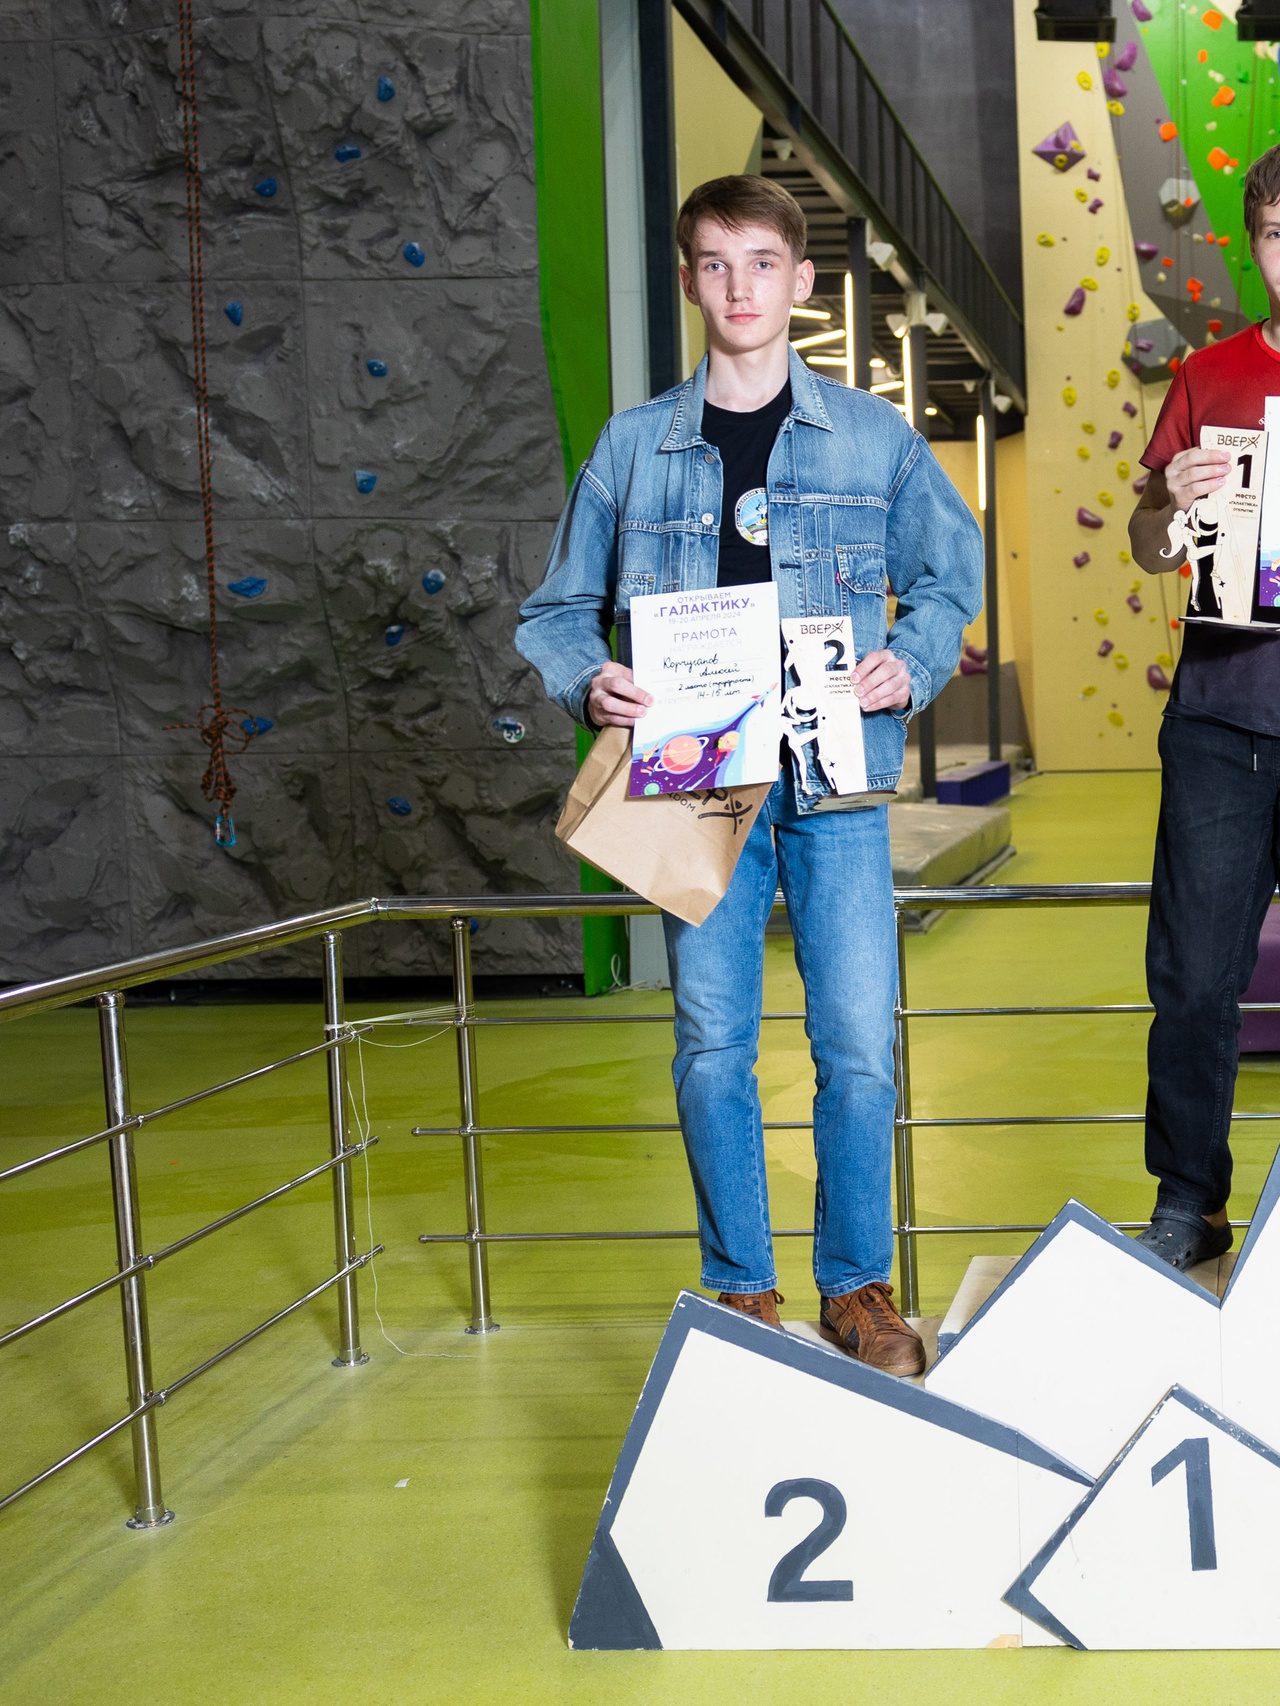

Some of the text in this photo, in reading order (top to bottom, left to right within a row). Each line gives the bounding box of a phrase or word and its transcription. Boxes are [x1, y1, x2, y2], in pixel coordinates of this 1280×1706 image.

[1217, 433, 1261, 452] ВВЕРХ
[1237, 454, 1253, 489] 1
[653, 597, 756, 618] «ГАЛАКТИКУ»
[677, 591, 731, 604] ОТКРЫВАЕМ
[690, 613, 721, 622] АПРЕЛЯ
[723, 611, 741, 619] 2024
[673, 627, 738, 643] ГРАМОТА
[799, 619, 845, 638] ВВЕРХ
[823, 639, 848, 672] 2
[1150, 1436, 1218, 1572] 1
[764, 1476, 855, 1603] 2
